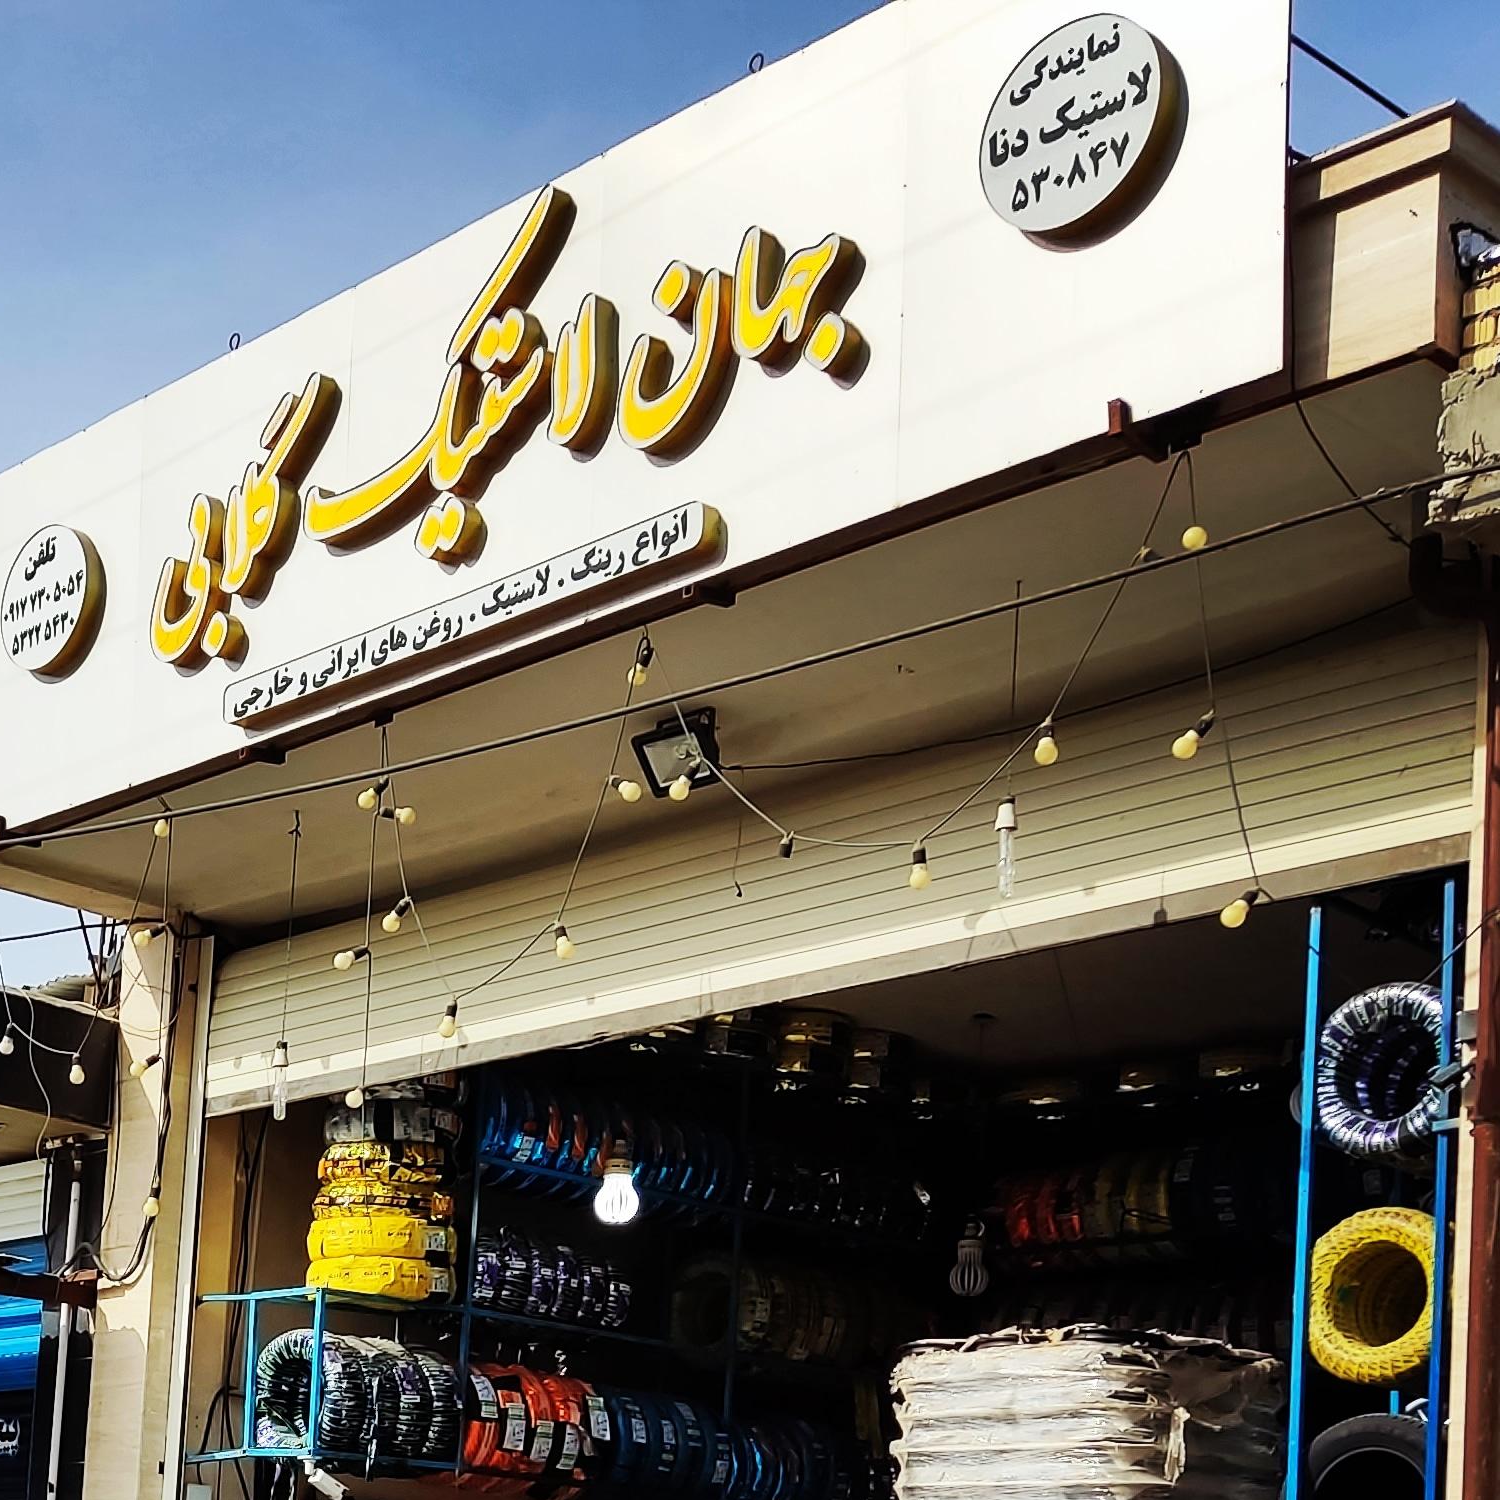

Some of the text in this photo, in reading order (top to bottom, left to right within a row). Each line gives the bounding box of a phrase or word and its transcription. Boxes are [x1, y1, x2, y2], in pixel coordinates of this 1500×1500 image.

[988, 62, 1152, 168] لاستیک دنا
[1011, 132, 1131, 212] ۵۳۰۸۴۷
[617, 224, 856, 455] جهان
[304, 184, 613, 561] لاستیک
[24, 535, 58, 582] تلفن
[631, 508, 688, 567] انواع
[481, 563, 551, 616] لاستیک
[370, 624, 408, 666] های
[412, 609, 463, 651] روغن
[297, 671, 308, 696] و
[312, 636, 367, 689] ایرانی
[233, 667, 294, 718] خارجی
